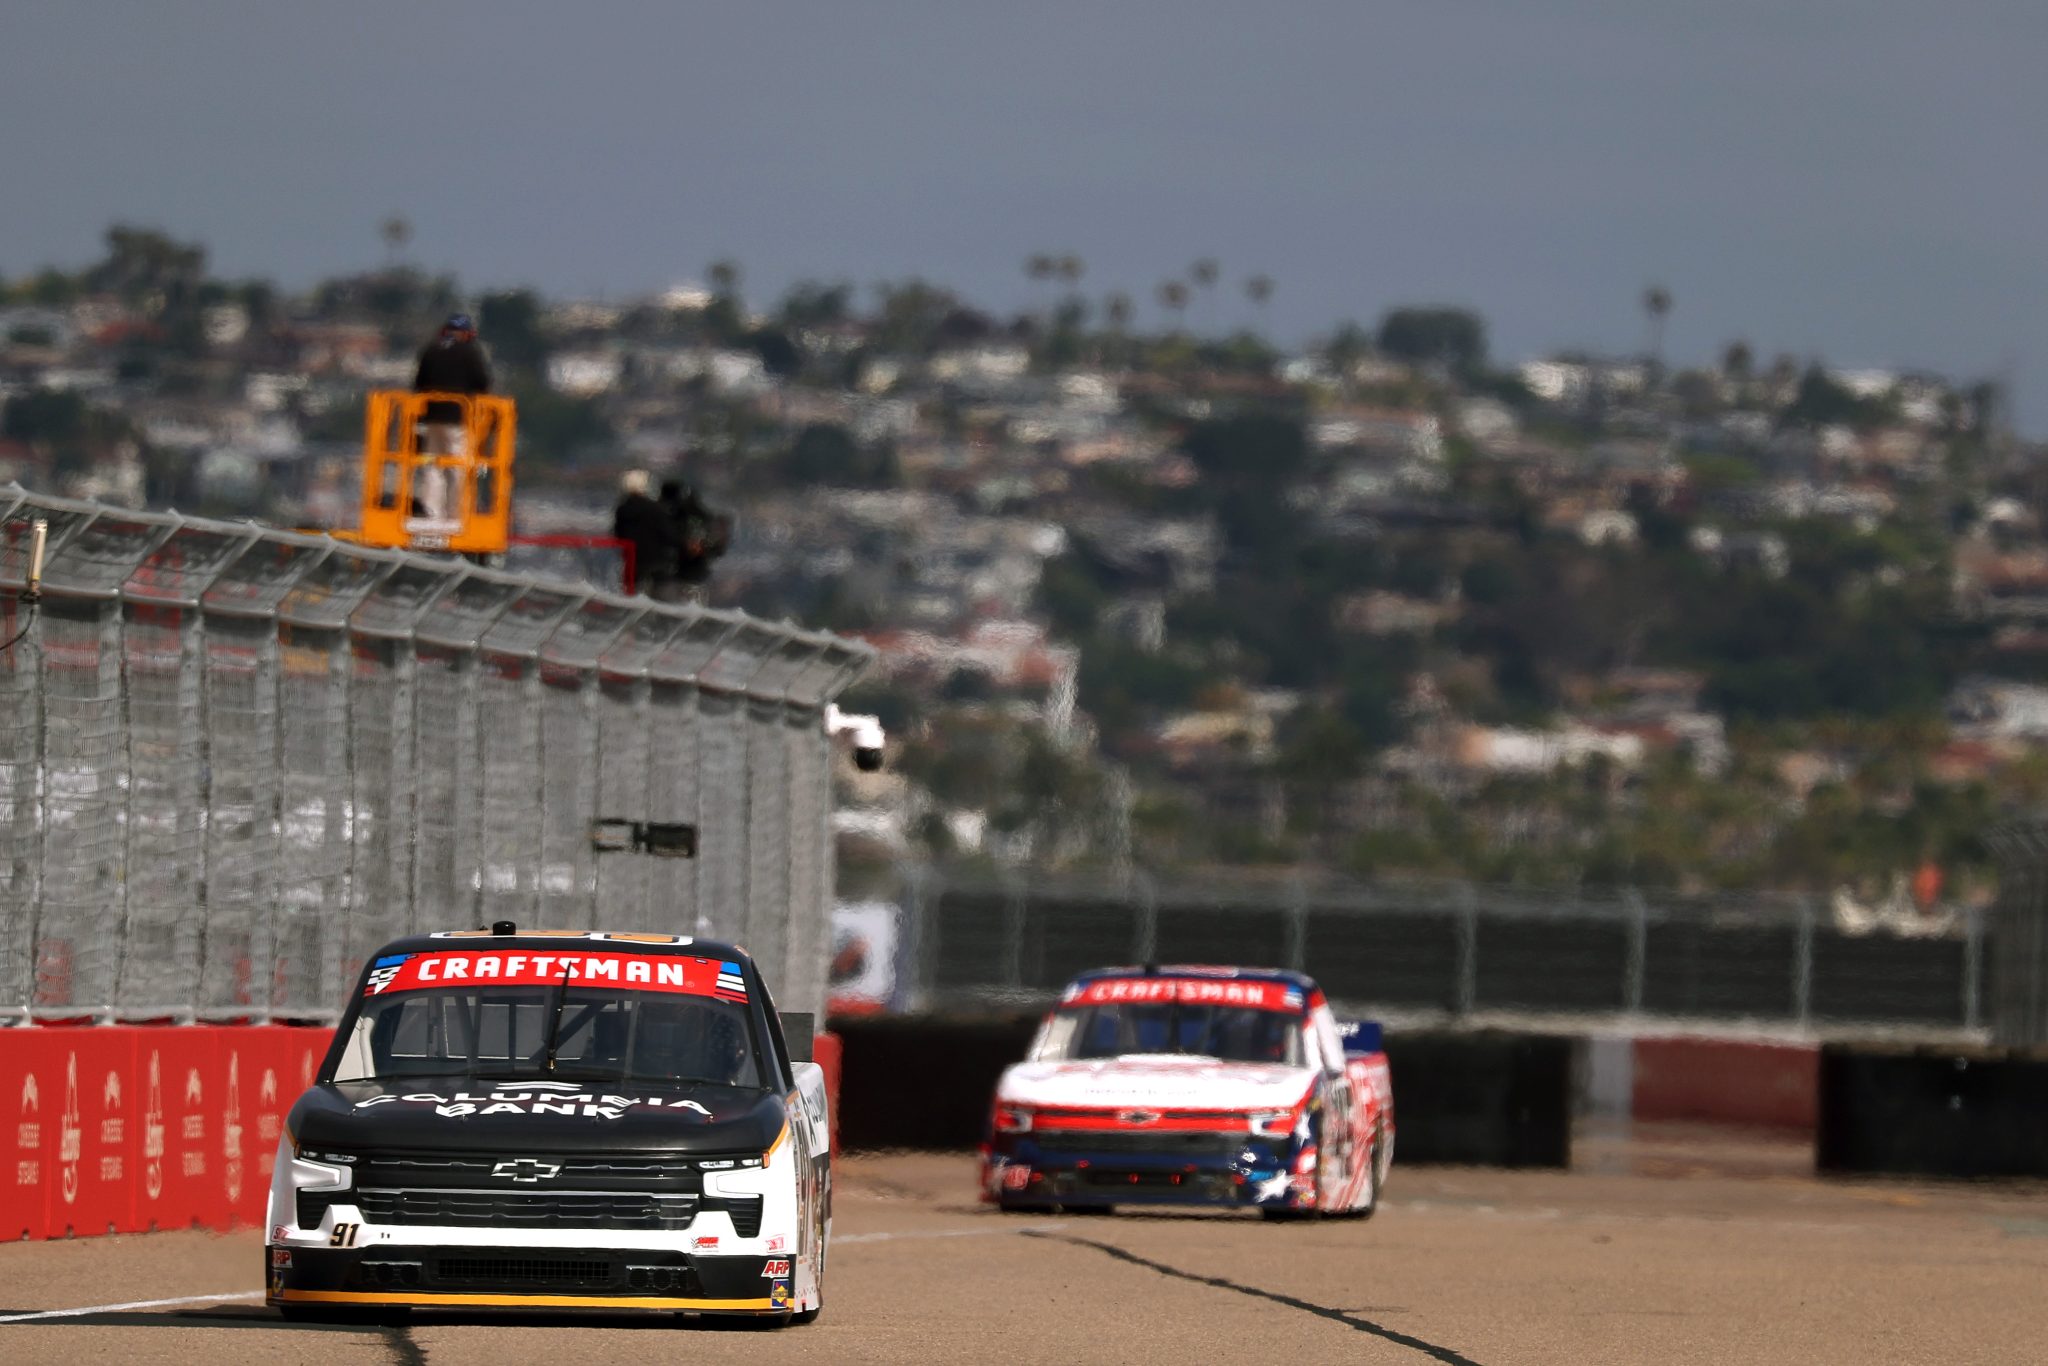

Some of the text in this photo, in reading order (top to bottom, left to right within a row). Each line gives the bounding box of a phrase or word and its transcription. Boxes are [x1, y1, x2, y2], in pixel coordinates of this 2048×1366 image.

[418, 956, 684, 986] CRAFTSMAN
[355, 1092, 713, 1116] COLUMBIA
[434, 1103, 625, 1120] BANK
[329, 1223, 361, 1247] 91
[764, 1261, 790, 1274] ARP
